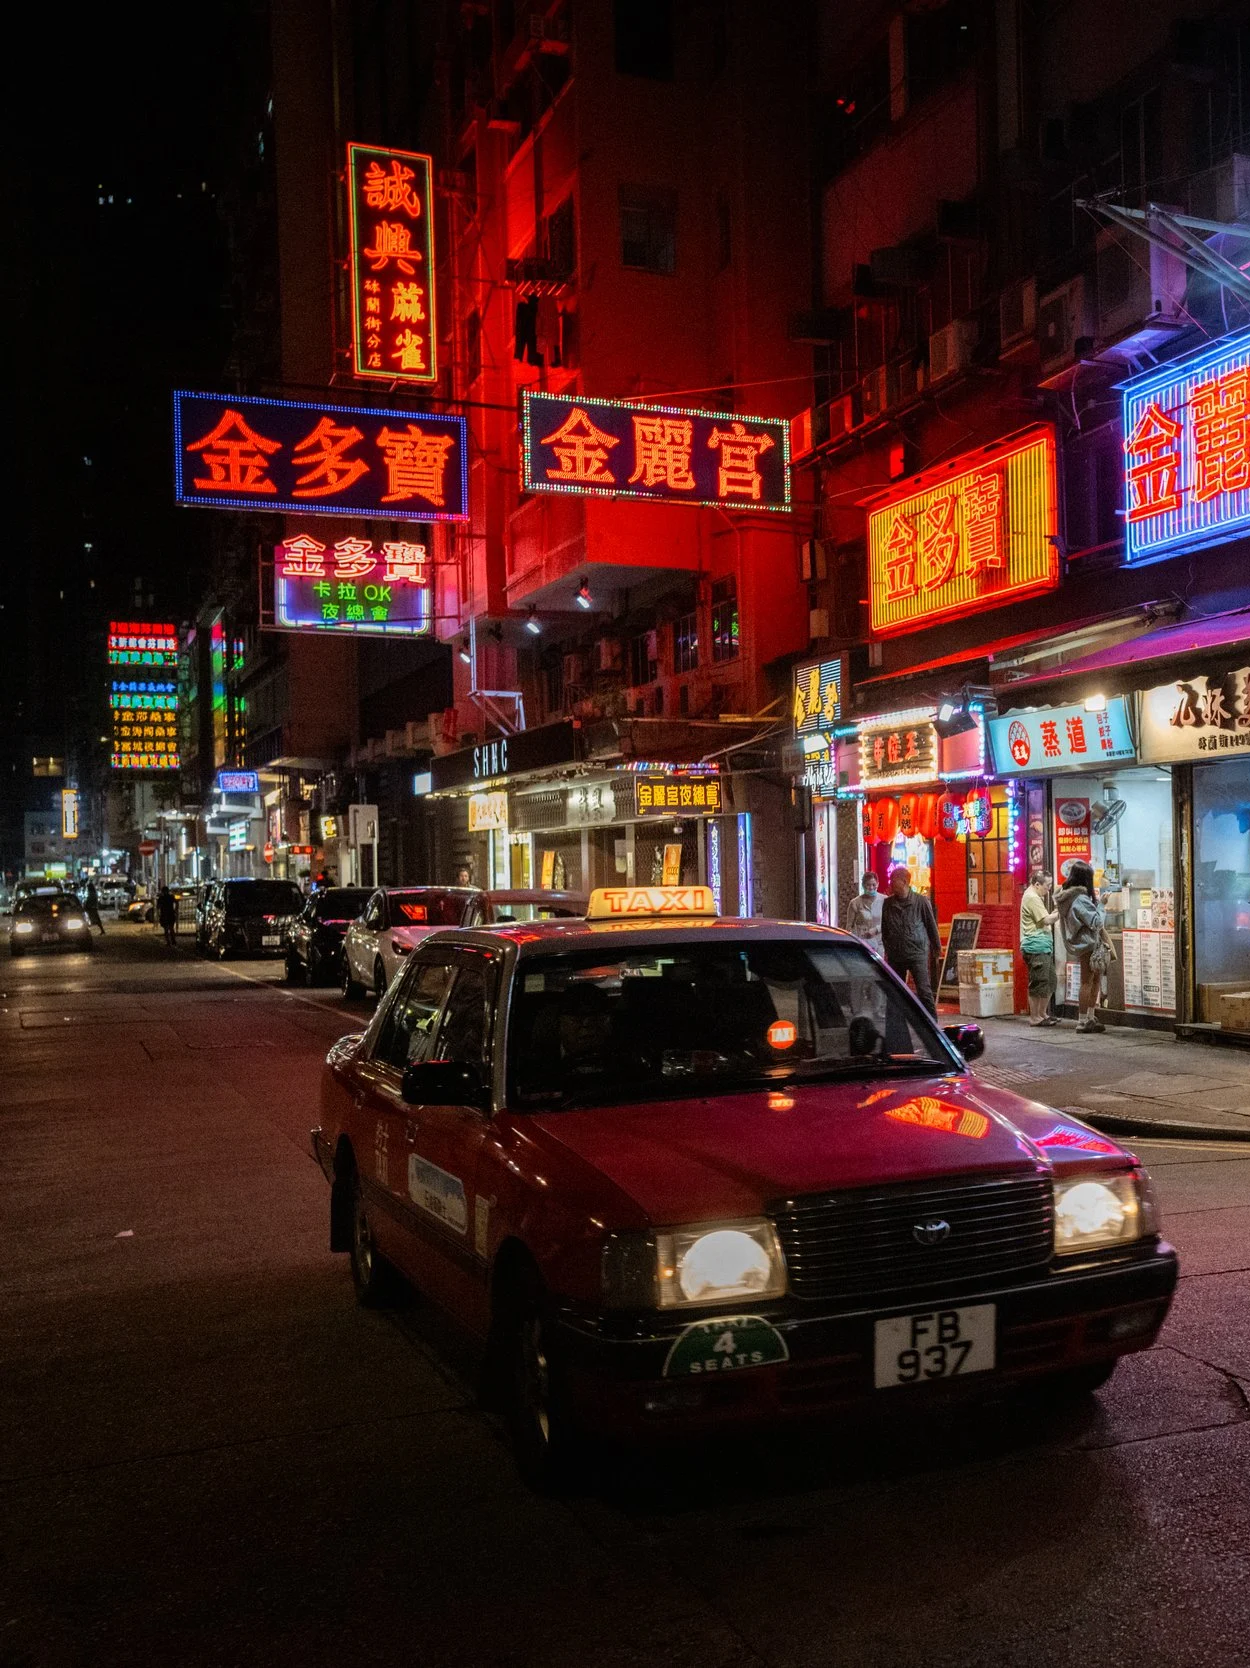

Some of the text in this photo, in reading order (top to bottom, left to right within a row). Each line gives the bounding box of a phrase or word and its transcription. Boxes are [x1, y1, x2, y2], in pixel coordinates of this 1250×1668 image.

[185, 408, 456, 507] 金多寶
[540, 406, 776, 501] 金麗宮
[884, 470, 1006, 604] 金多寶
[281, 534, 427, 583] 金多寶
[312, 581, 393, 602] 卡拉OK
[321, 603, 389, 621] 夜總會
[1040, 716, 1087, 758] 蒸道
[639, 784, 718, 806] 金麗宮夜總會
[603, 889, 706, 914] TAXI
[769, 1027, 794, 1042] TAXI
[713, 1330, 737, 1355] 4
[911, 1310, 961, 1349] FB
[689, 1351, 763, 1374] SEATS
[896, 1340, 973, 1384] 937
